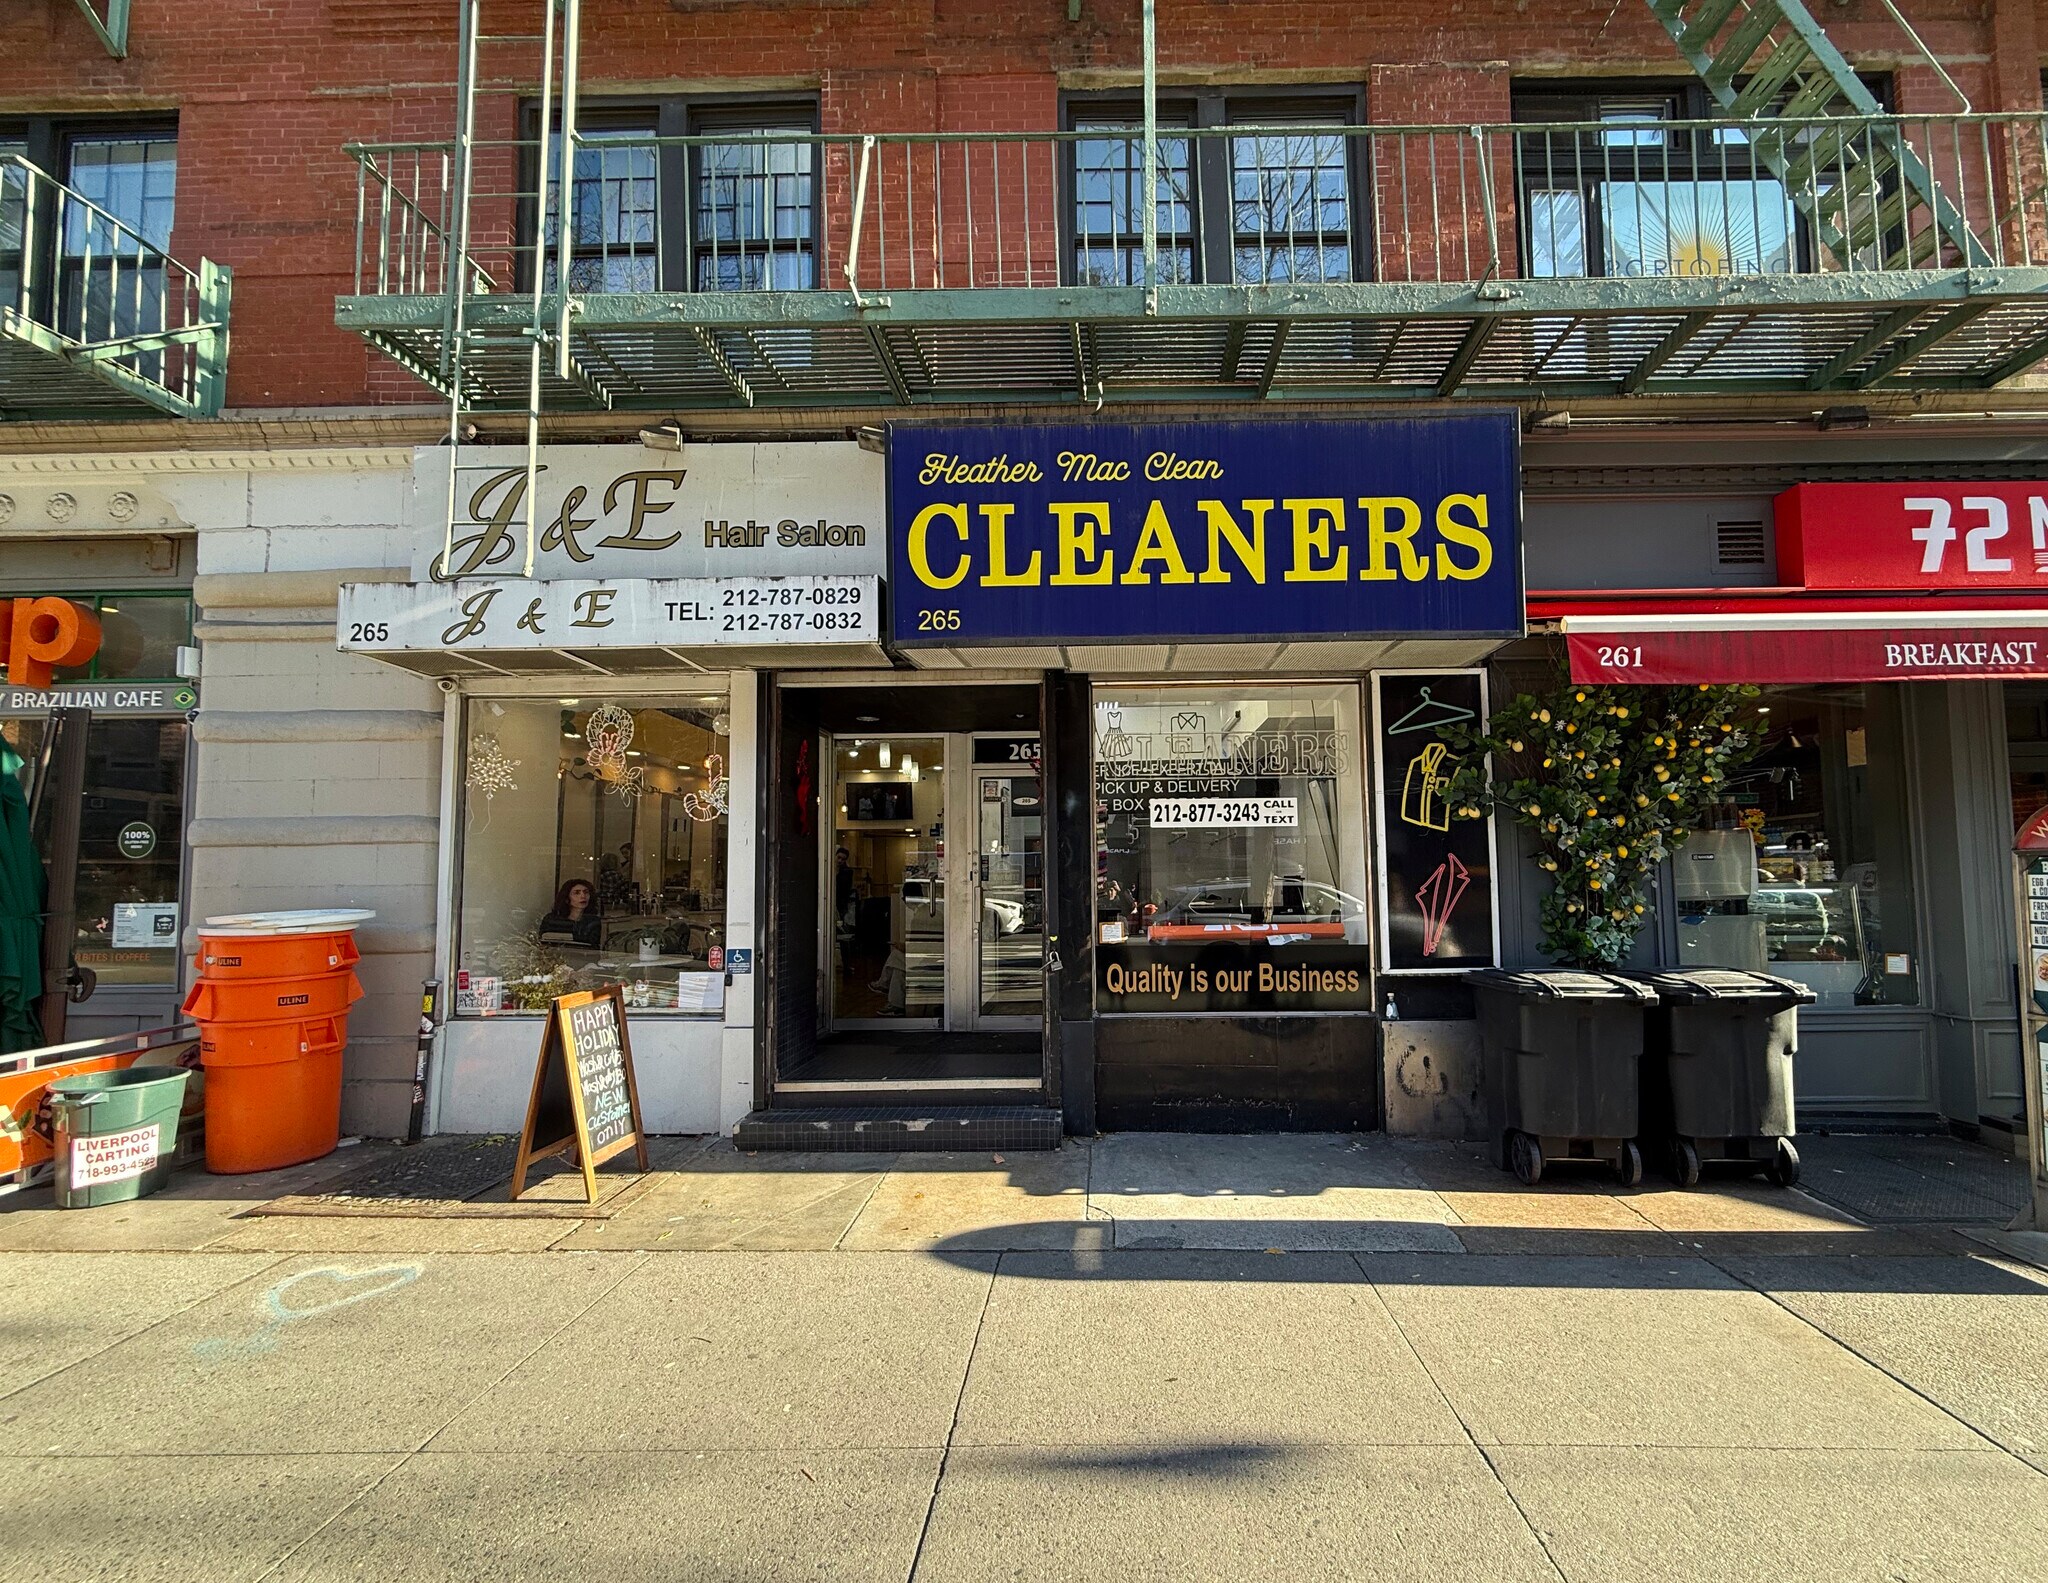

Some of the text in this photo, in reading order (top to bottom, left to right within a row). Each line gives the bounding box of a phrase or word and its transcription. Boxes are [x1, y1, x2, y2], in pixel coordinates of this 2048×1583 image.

[918, 451, 1224, 485] Heather Mac Clean
[540, 486, 597, 563] &
[595, 469, 687, 550] E
[704, 519, 769, 548] Hair
[777, 520, 866, 547] Salon
[907, 493, 1493, 589] CLEANERS
[1904, 496, 2012, 573] 72
[517, 598, 545, 634] &
[569, 590, 618, 628] E
[664, 602, 715, 621] TEL:
[723, 588, 862, 606] 212-787-0829
[723, 612, 862, 631] 212-787-0832
[918, 610, 961, 631] 265
[350, 622, 389, 642] 265
[1598, 642, 2037, 667] 261 BREAKFAST
[11, 691, 107, 709] BRAZILIAN
[114, 691, 163, 707] CAFE
[1103, 733, 1350, 777] CLEANERS
[1130, 781, 1150, 794] UP
[1154, 781, 1164, 793] &
[1168, 780, 1240, 793] DELIVERY
[1113, 798, 1145, 811] BOX
[1153, 800, 1295, 823] 212-877-3243 CALL
[1264, 815, 1295, 824] TEXT
[125, 831, 151, 839] 100%
[1106, 963, 1360, 1000] Quality is our Business
[279, 995, 308, 1005] ULINE
[573, 1002, 615, 1036] HAPPY
[574, 1023, 621, 1057] HOLIDAY
[594, 1085, 623, 1112] NEW
[78, 1129, 156, 1152] LIVERPOOL
[86, 1143, 150, 1164] CARTING
